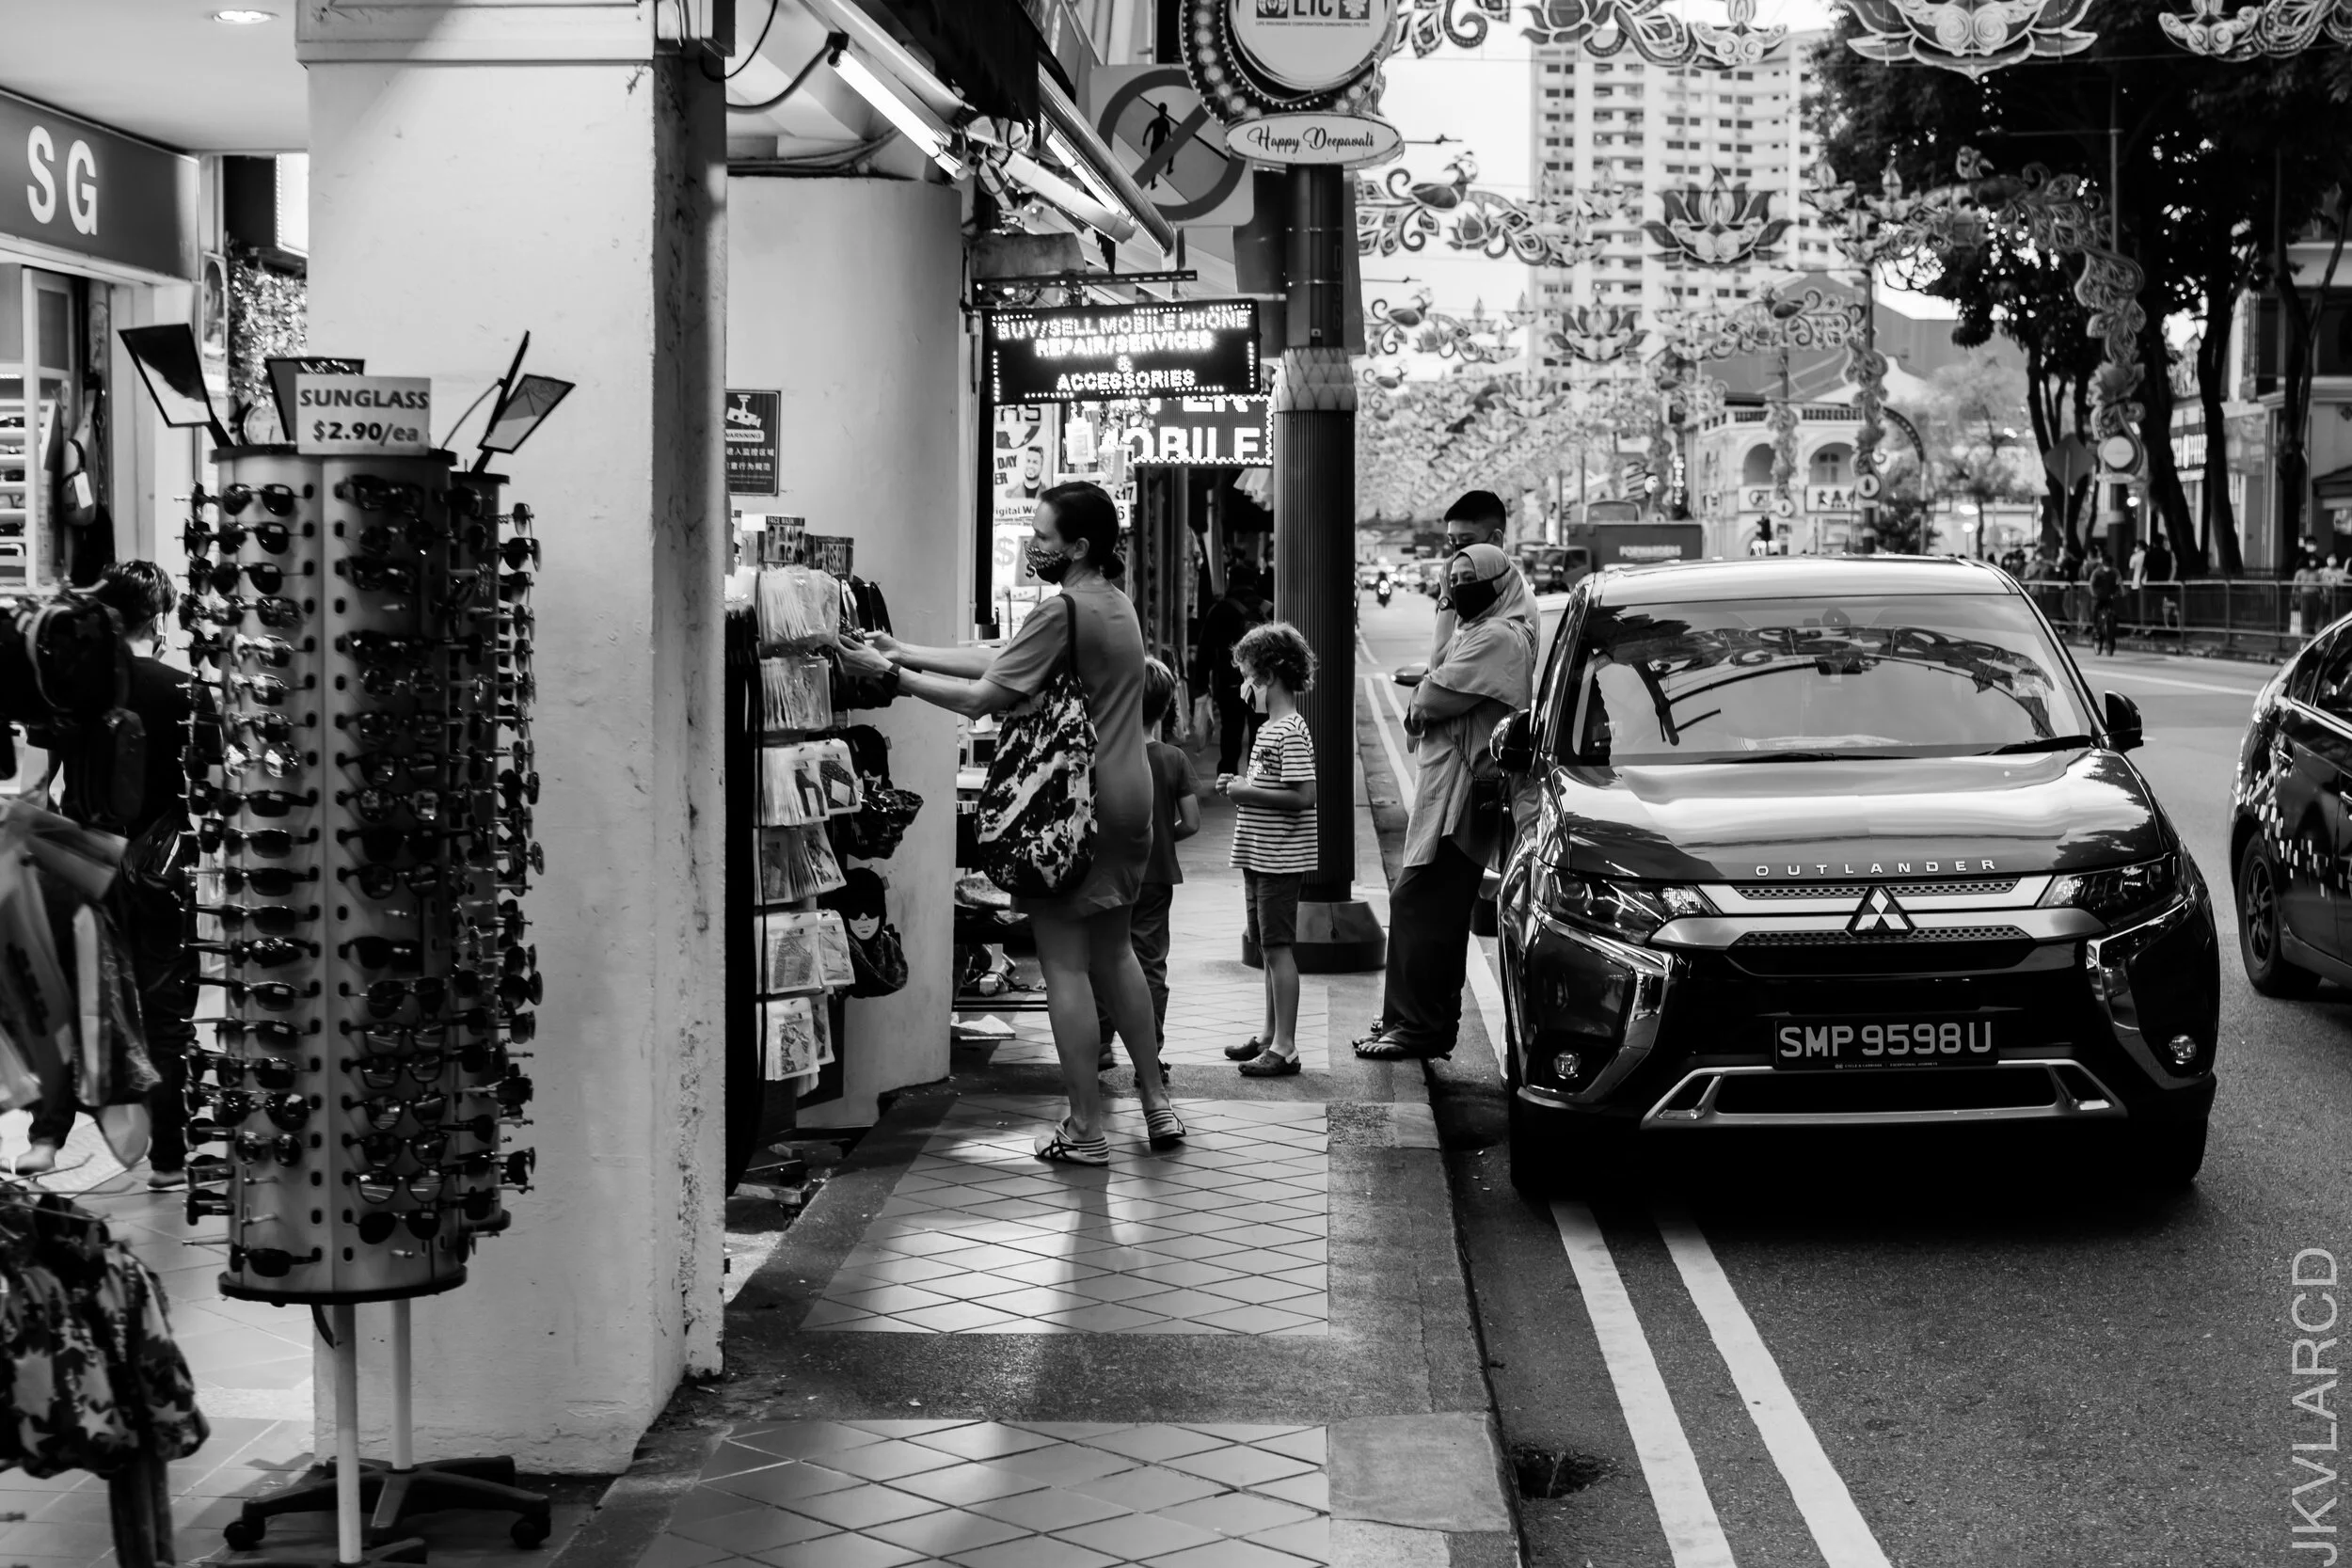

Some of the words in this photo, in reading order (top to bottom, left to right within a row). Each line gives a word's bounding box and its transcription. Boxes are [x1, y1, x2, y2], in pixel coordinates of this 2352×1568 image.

[1247, 125, 1299, 154] Happy
[1302, 126, 1374, 153] Deepavali
[1099, 313, 1176, 334] MOBILE
[1181, 310, 1248, 329] PHONE
[1035, 330, 1214, 357] REPAIR/SERVICES
[1057, 369, 1195, 391] ACCESSORIES
[299, 388, 430, 409] SUNGLASS
[312, 420, 420, 447] $2.90/ea
[1103, 426, 1261, 460] OBILE
[997, 456, 1017, 469] DAY
[995, 507, 1020, 516] igital
[1756, 859, 1995, 877] OUTLANDER
[1780, 1025, 1854, 1057] SMP
[1861, 1022, 1962, 1056] 9598
[1969, 1022, 1992, 1053] U
